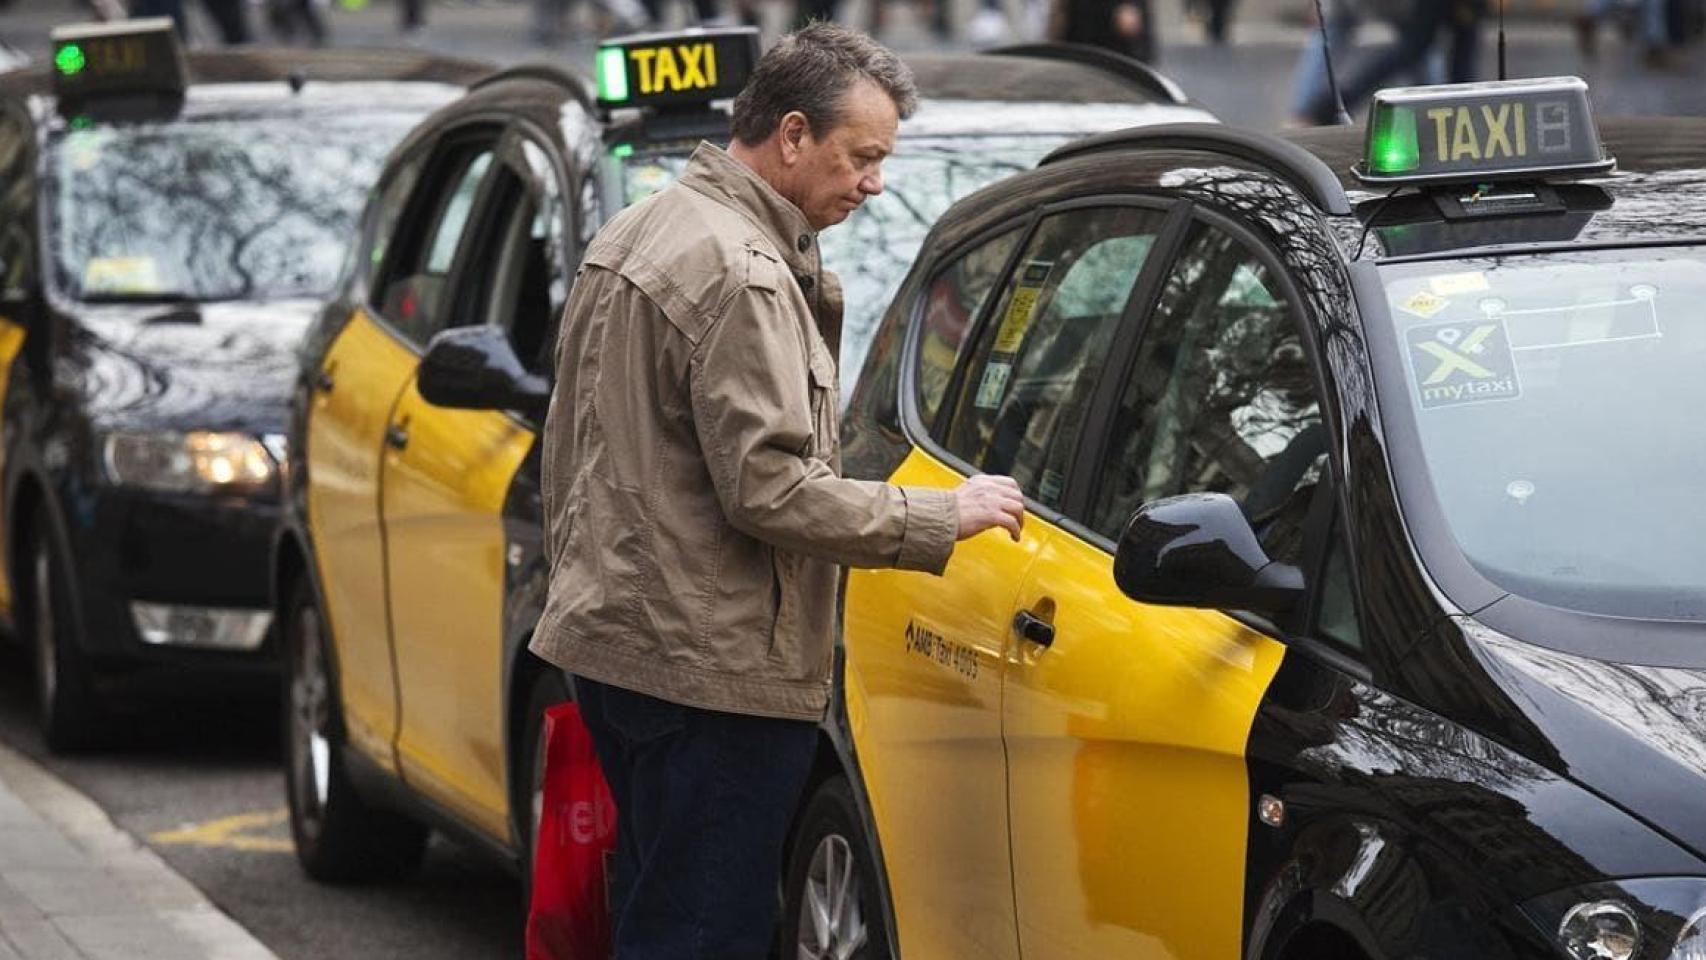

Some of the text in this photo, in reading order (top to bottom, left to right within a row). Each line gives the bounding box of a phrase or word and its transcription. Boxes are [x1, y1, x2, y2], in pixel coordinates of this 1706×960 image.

[630, 43, 717, 94] TAXI
[1427, 102, 1527, 162] TAXI
[1423, 376, 1514, 401] mytaxi
